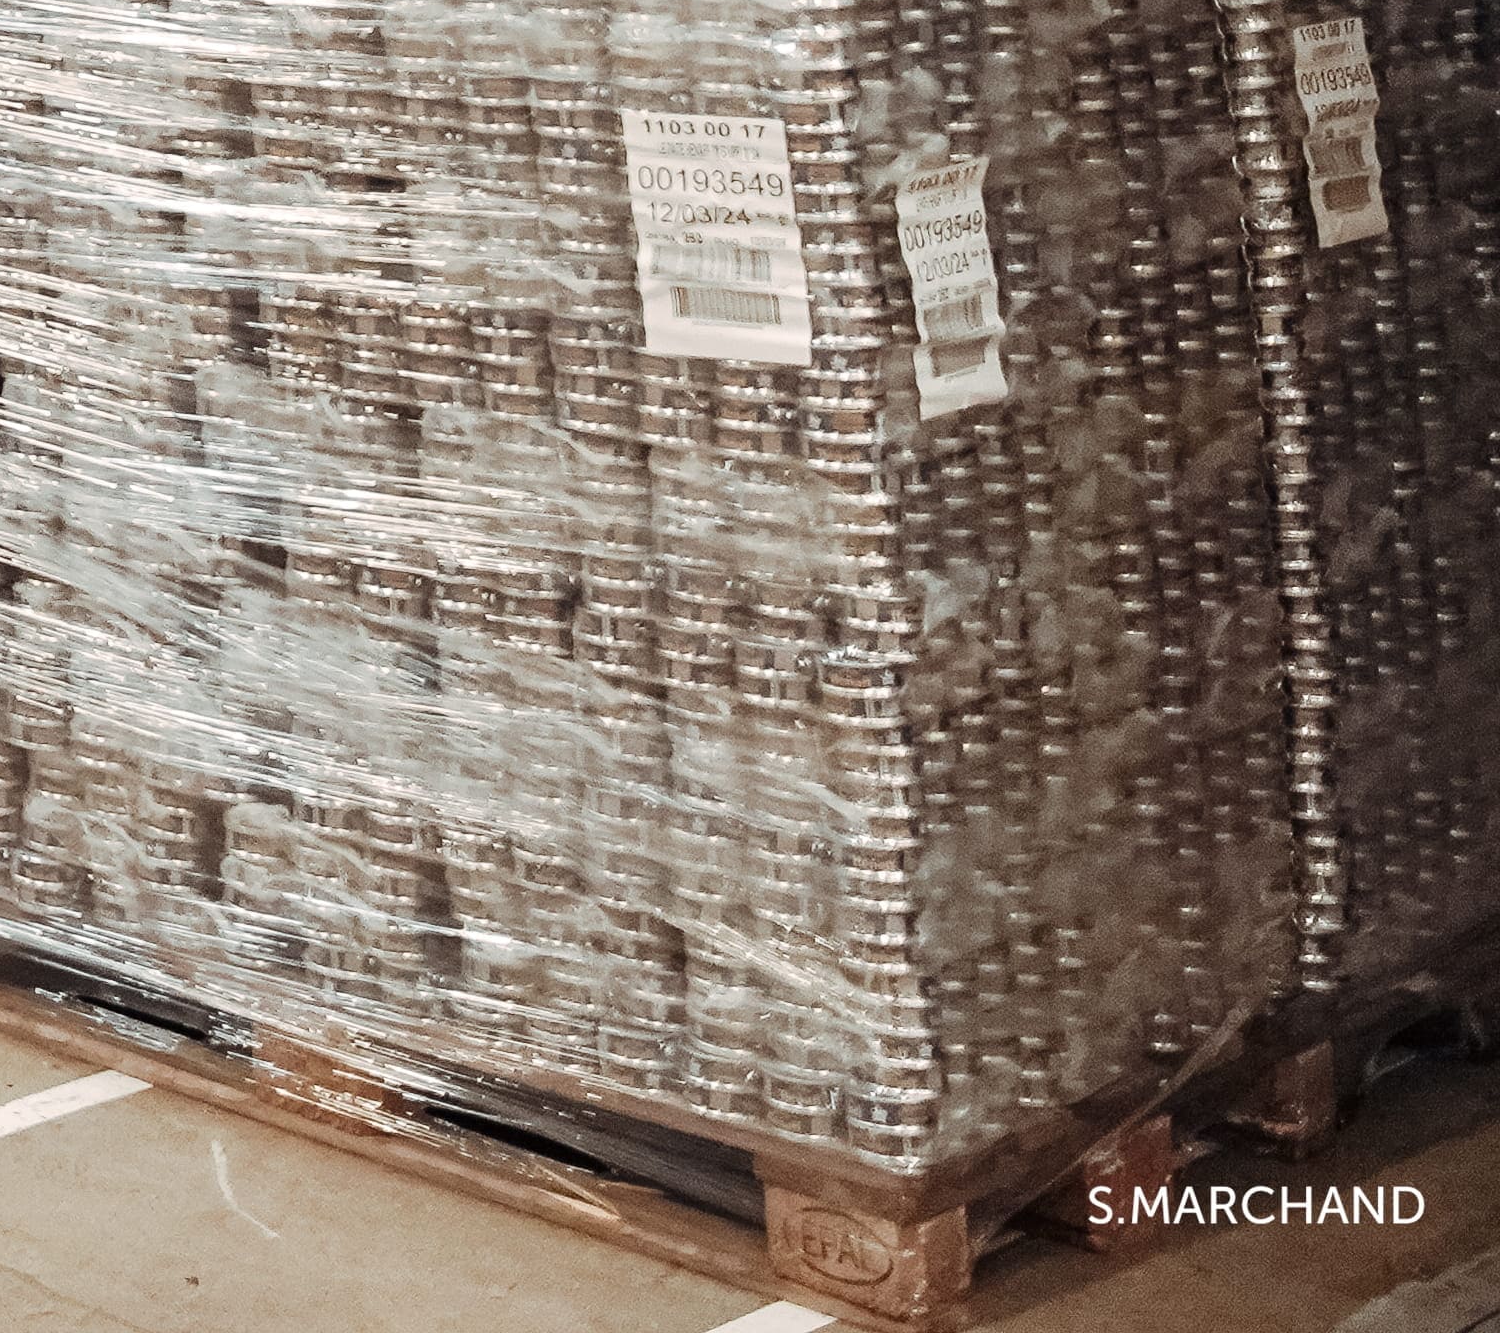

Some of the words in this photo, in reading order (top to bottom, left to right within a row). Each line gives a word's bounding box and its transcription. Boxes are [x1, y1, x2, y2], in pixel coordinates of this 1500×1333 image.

[643, 119, 695, 135] 1103
[704, 122, 730, 137] 00
[744, 123, 766, 139] 17
[637, 166, 784, 197] 00193549
[649, 201, 752, 225] 12/03/24
[904, 210, 984, 252] 00193549
